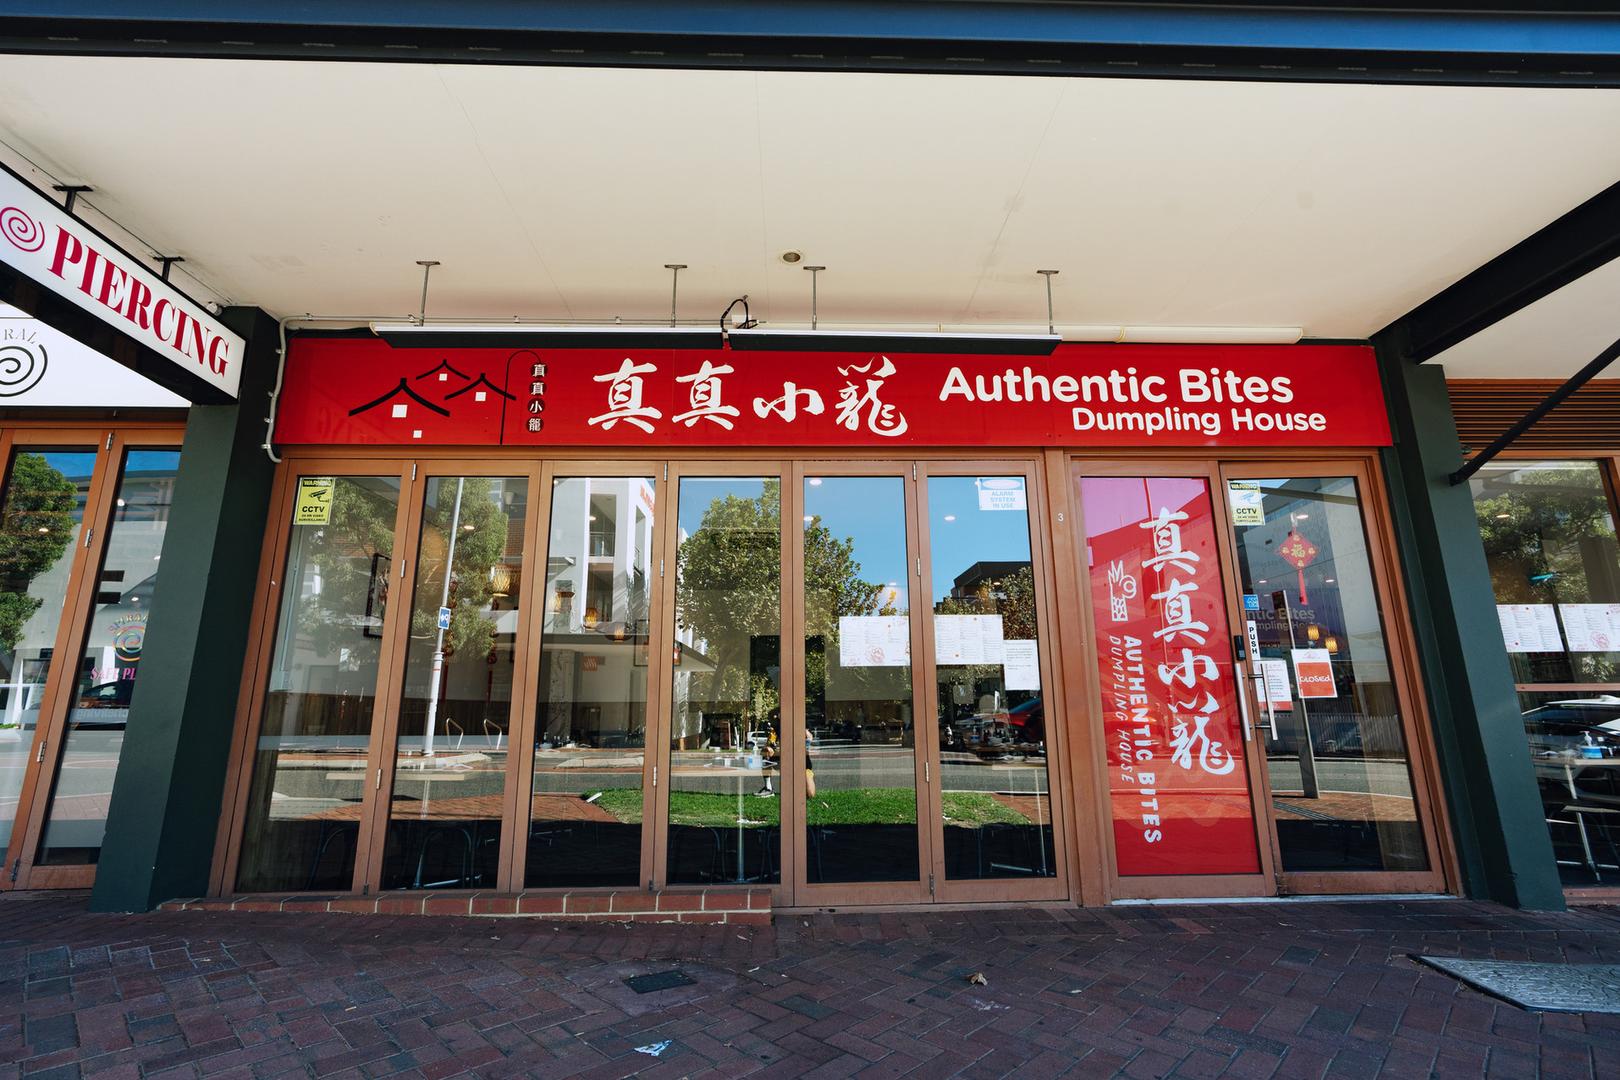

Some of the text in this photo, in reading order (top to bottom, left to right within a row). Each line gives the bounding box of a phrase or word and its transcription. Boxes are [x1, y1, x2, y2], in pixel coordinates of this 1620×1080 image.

[48, 224, 230, 378] PIERCING
[3, 327, 38, 345] RAL
[939, 366, 1294, 404] Authentic Bites
[1072, 406, 1327, 436] Dumpling House
[301, 505, 325, 513] CCTV
[1057, 512, 1064, 521] 3
[1249, 626, 1258, 655] PUSH
[1256, 621, 1289, 631] mpling
[1108, 635, 1135, 784] DUMPLING HOUSE
[1123, 635, 1163, 844] AUTHENTIC BITES
